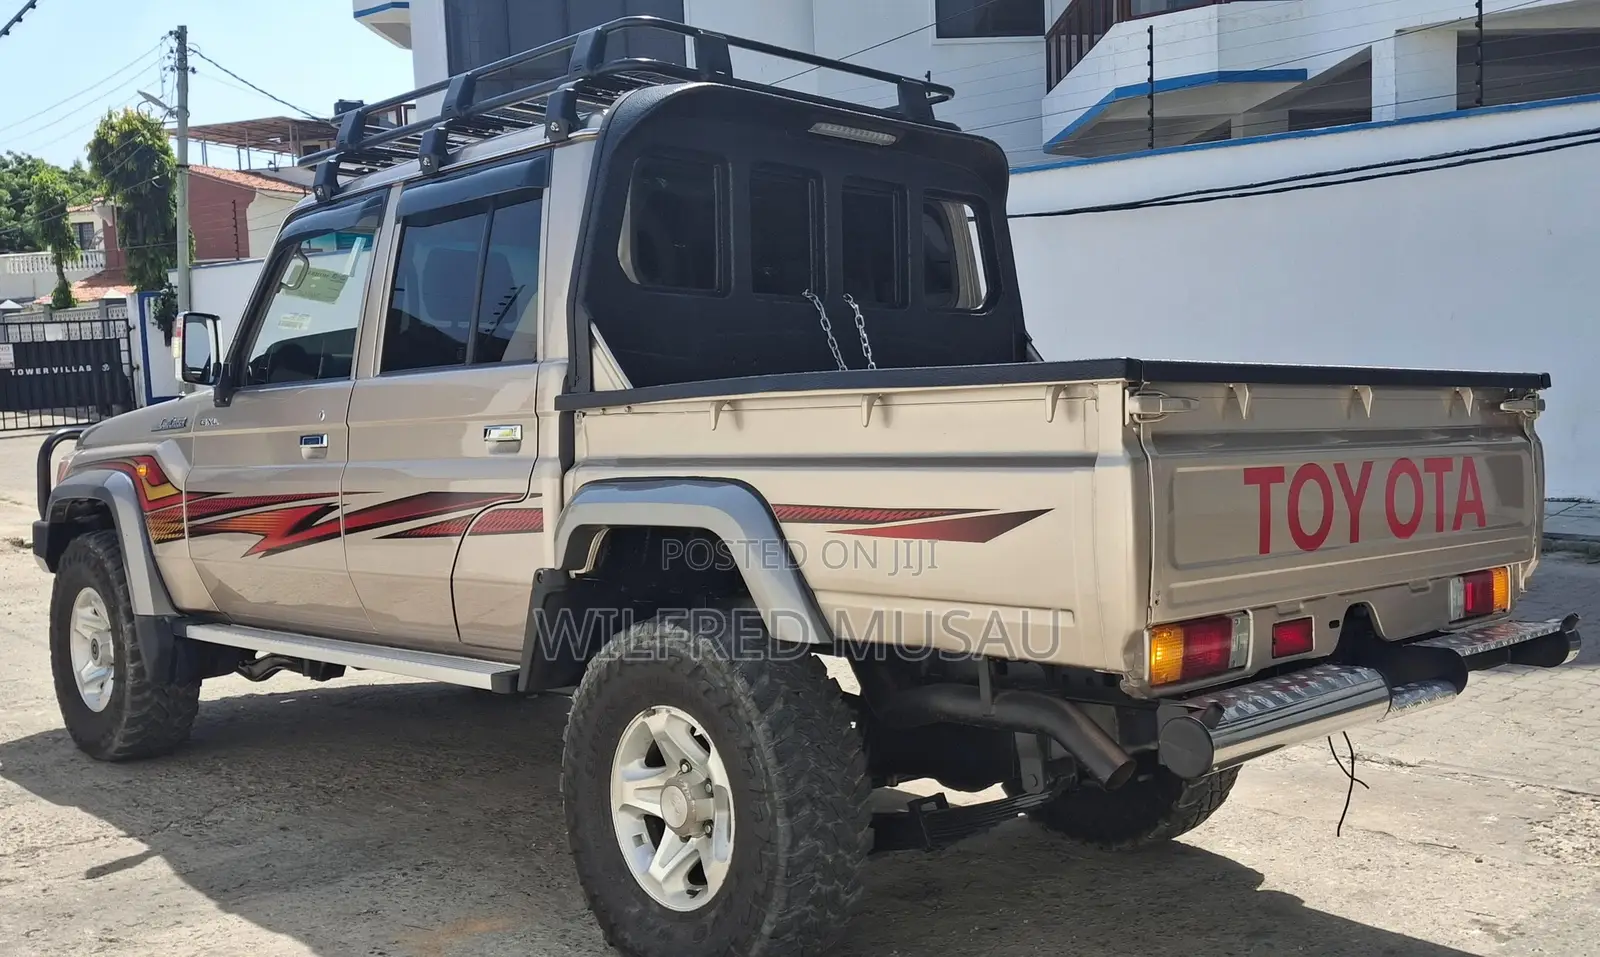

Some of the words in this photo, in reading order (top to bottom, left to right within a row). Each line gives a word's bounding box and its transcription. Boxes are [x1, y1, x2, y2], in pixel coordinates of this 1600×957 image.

[10, 367, 49, 376] TOWER
[52, 364, 92, 374] VILLAS
[1244, 456, 1486, 555] TOYOTA
